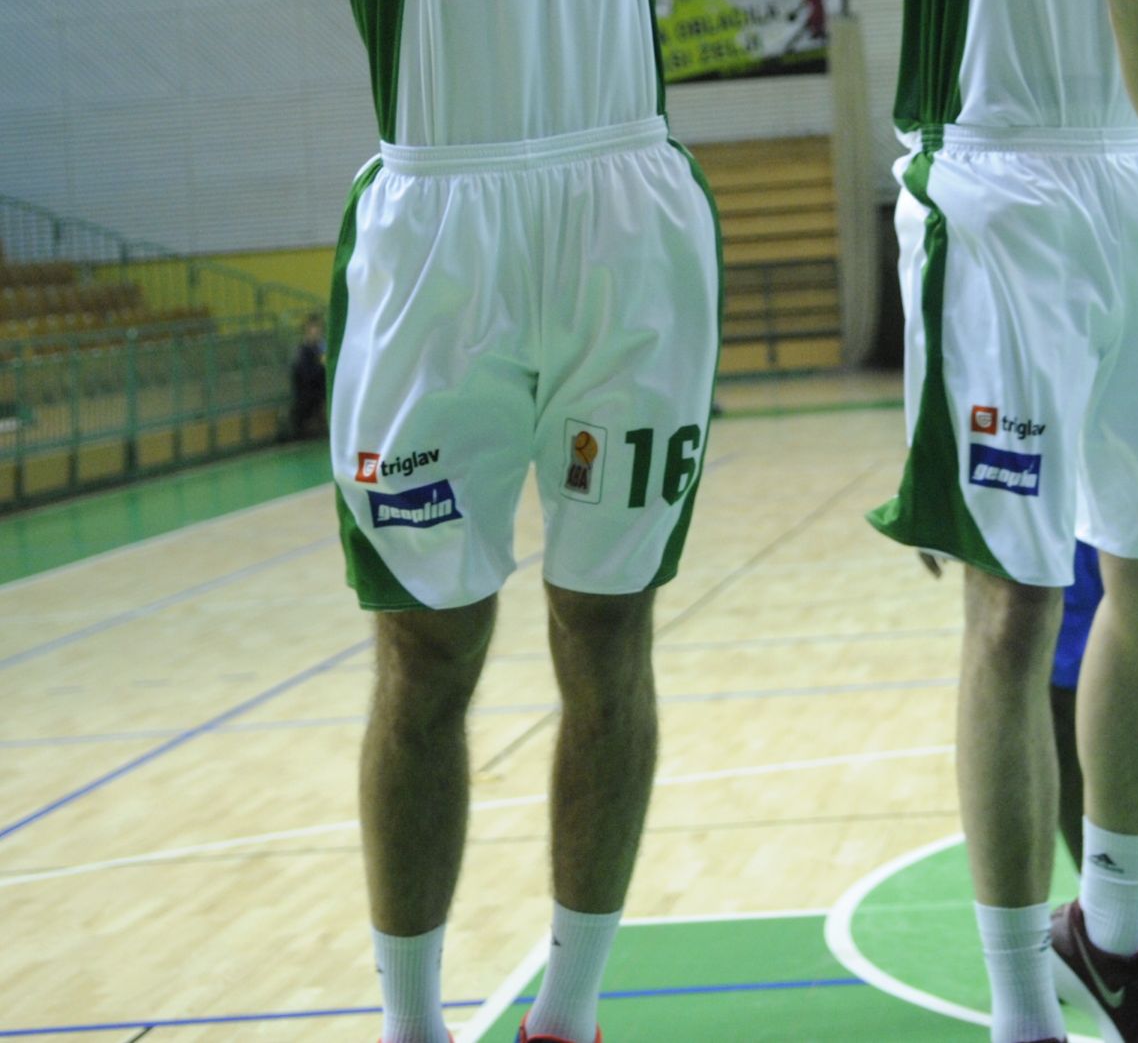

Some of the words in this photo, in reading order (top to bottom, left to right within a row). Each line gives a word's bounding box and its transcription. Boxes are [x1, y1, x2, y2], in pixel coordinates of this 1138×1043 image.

[1002, 415, 1047, 440] triglav
[381, 448, 440, 477] triglav
[625, 424, 701, 508] 16
